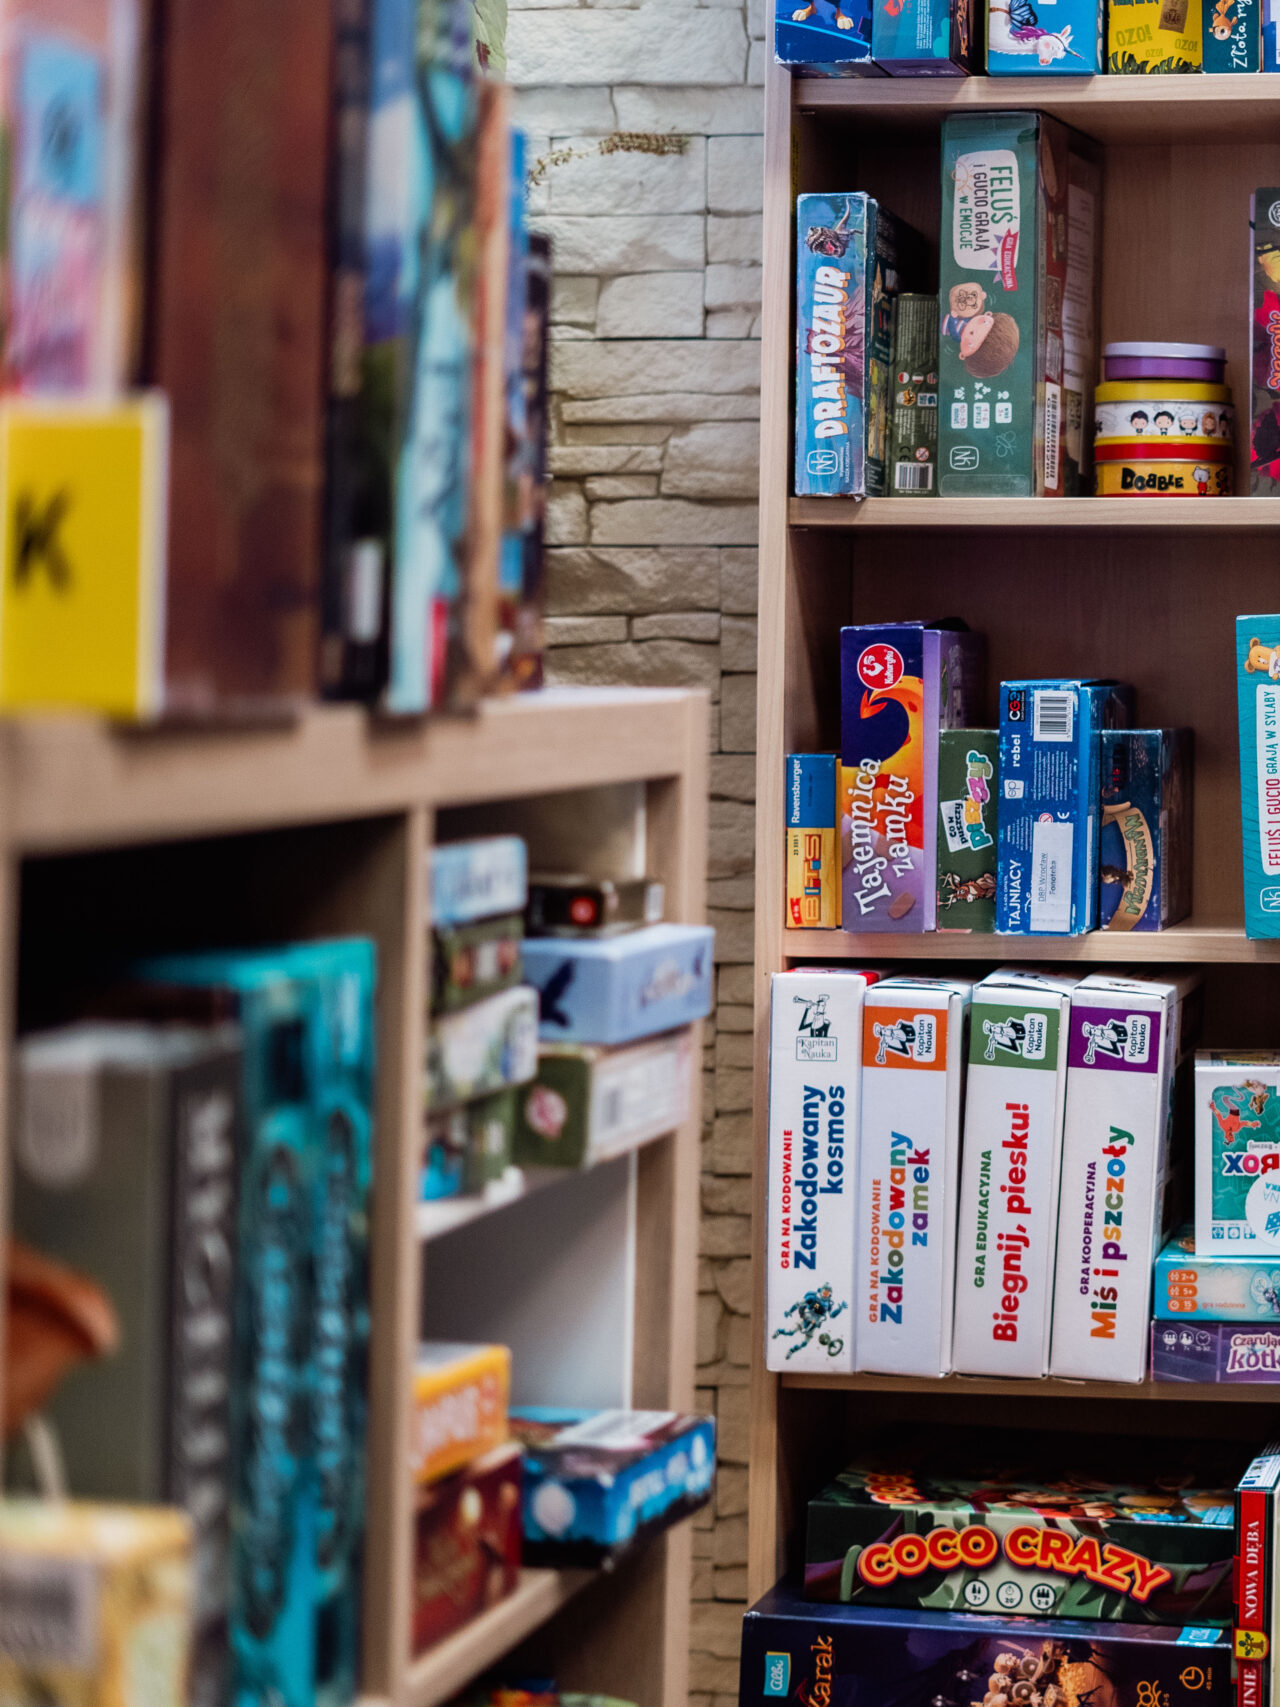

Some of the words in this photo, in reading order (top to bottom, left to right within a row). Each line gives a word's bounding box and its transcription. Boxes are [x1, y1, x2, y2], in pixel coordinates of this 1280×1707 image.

[1115, 24, 1153, 47] OZO!
[989, 166, 1018, 225] FELUŚ
[811, 266, 851, 439] DRAFTOZAUR
[1263, 690, 1277, 728] SYLABY
[1012, 734, 1021, 768] rebel
[791, 758, 803, 824] Ravensburger
[1267, 778, 1280, 815] GUCIO
[853, 757, 892, 915] Tajemnica
[876, 774, 915, 878] zamku
[1009, 859, 1022, 928] TAJNIACY
[916, 1019, 925, 1057] Kapitan
[925, 1022, 933, 1054] Nauka
[1035, 1021, 1044, 1051] Nauka
[1128, 1019, 1137, 1057] Kapitan
[820, 1085, 845, 1194] kosmos
[1000, 1103, 1032, 1215] piesku!
[782, 1129, 792, 1214] KODOWANIE
[794, 1085, 825, 1270] Zakodowany
[912, 1148, 930, 1247] zamek
[975, 1150, 991, 1251] EDUKACYJNA
[1102, 1125, 1135, 1261] pszczoły
[781, 1218, 791, 1237] NA
[870, 1179, 881, 1266] KODOWANIE
[880, 1131, 913, 1325] Zakodowany
[1082, 1161, 1096, 1264] KOOPERACYJNA
[781, 1240, 790, 1269] GRA
[870, 1270, 879, 1289] NA
[974, 1255, 986, 1288] GRA
[993, 1223, 1031, 1342] Biegnij,
[1080, 1267, 1090, 1295] GRA
[869, 1293, 878, 1323] GRA
[1090, 1287, 1118, 1339] Miś
[858, 1524, 998, 1589] COCO
[1004, 1525, 1173, 1601] CRAZY
[1246, 1521, 1262, 1565] DĘBA
[1245, 1570, 1258, 1620] NOWA
